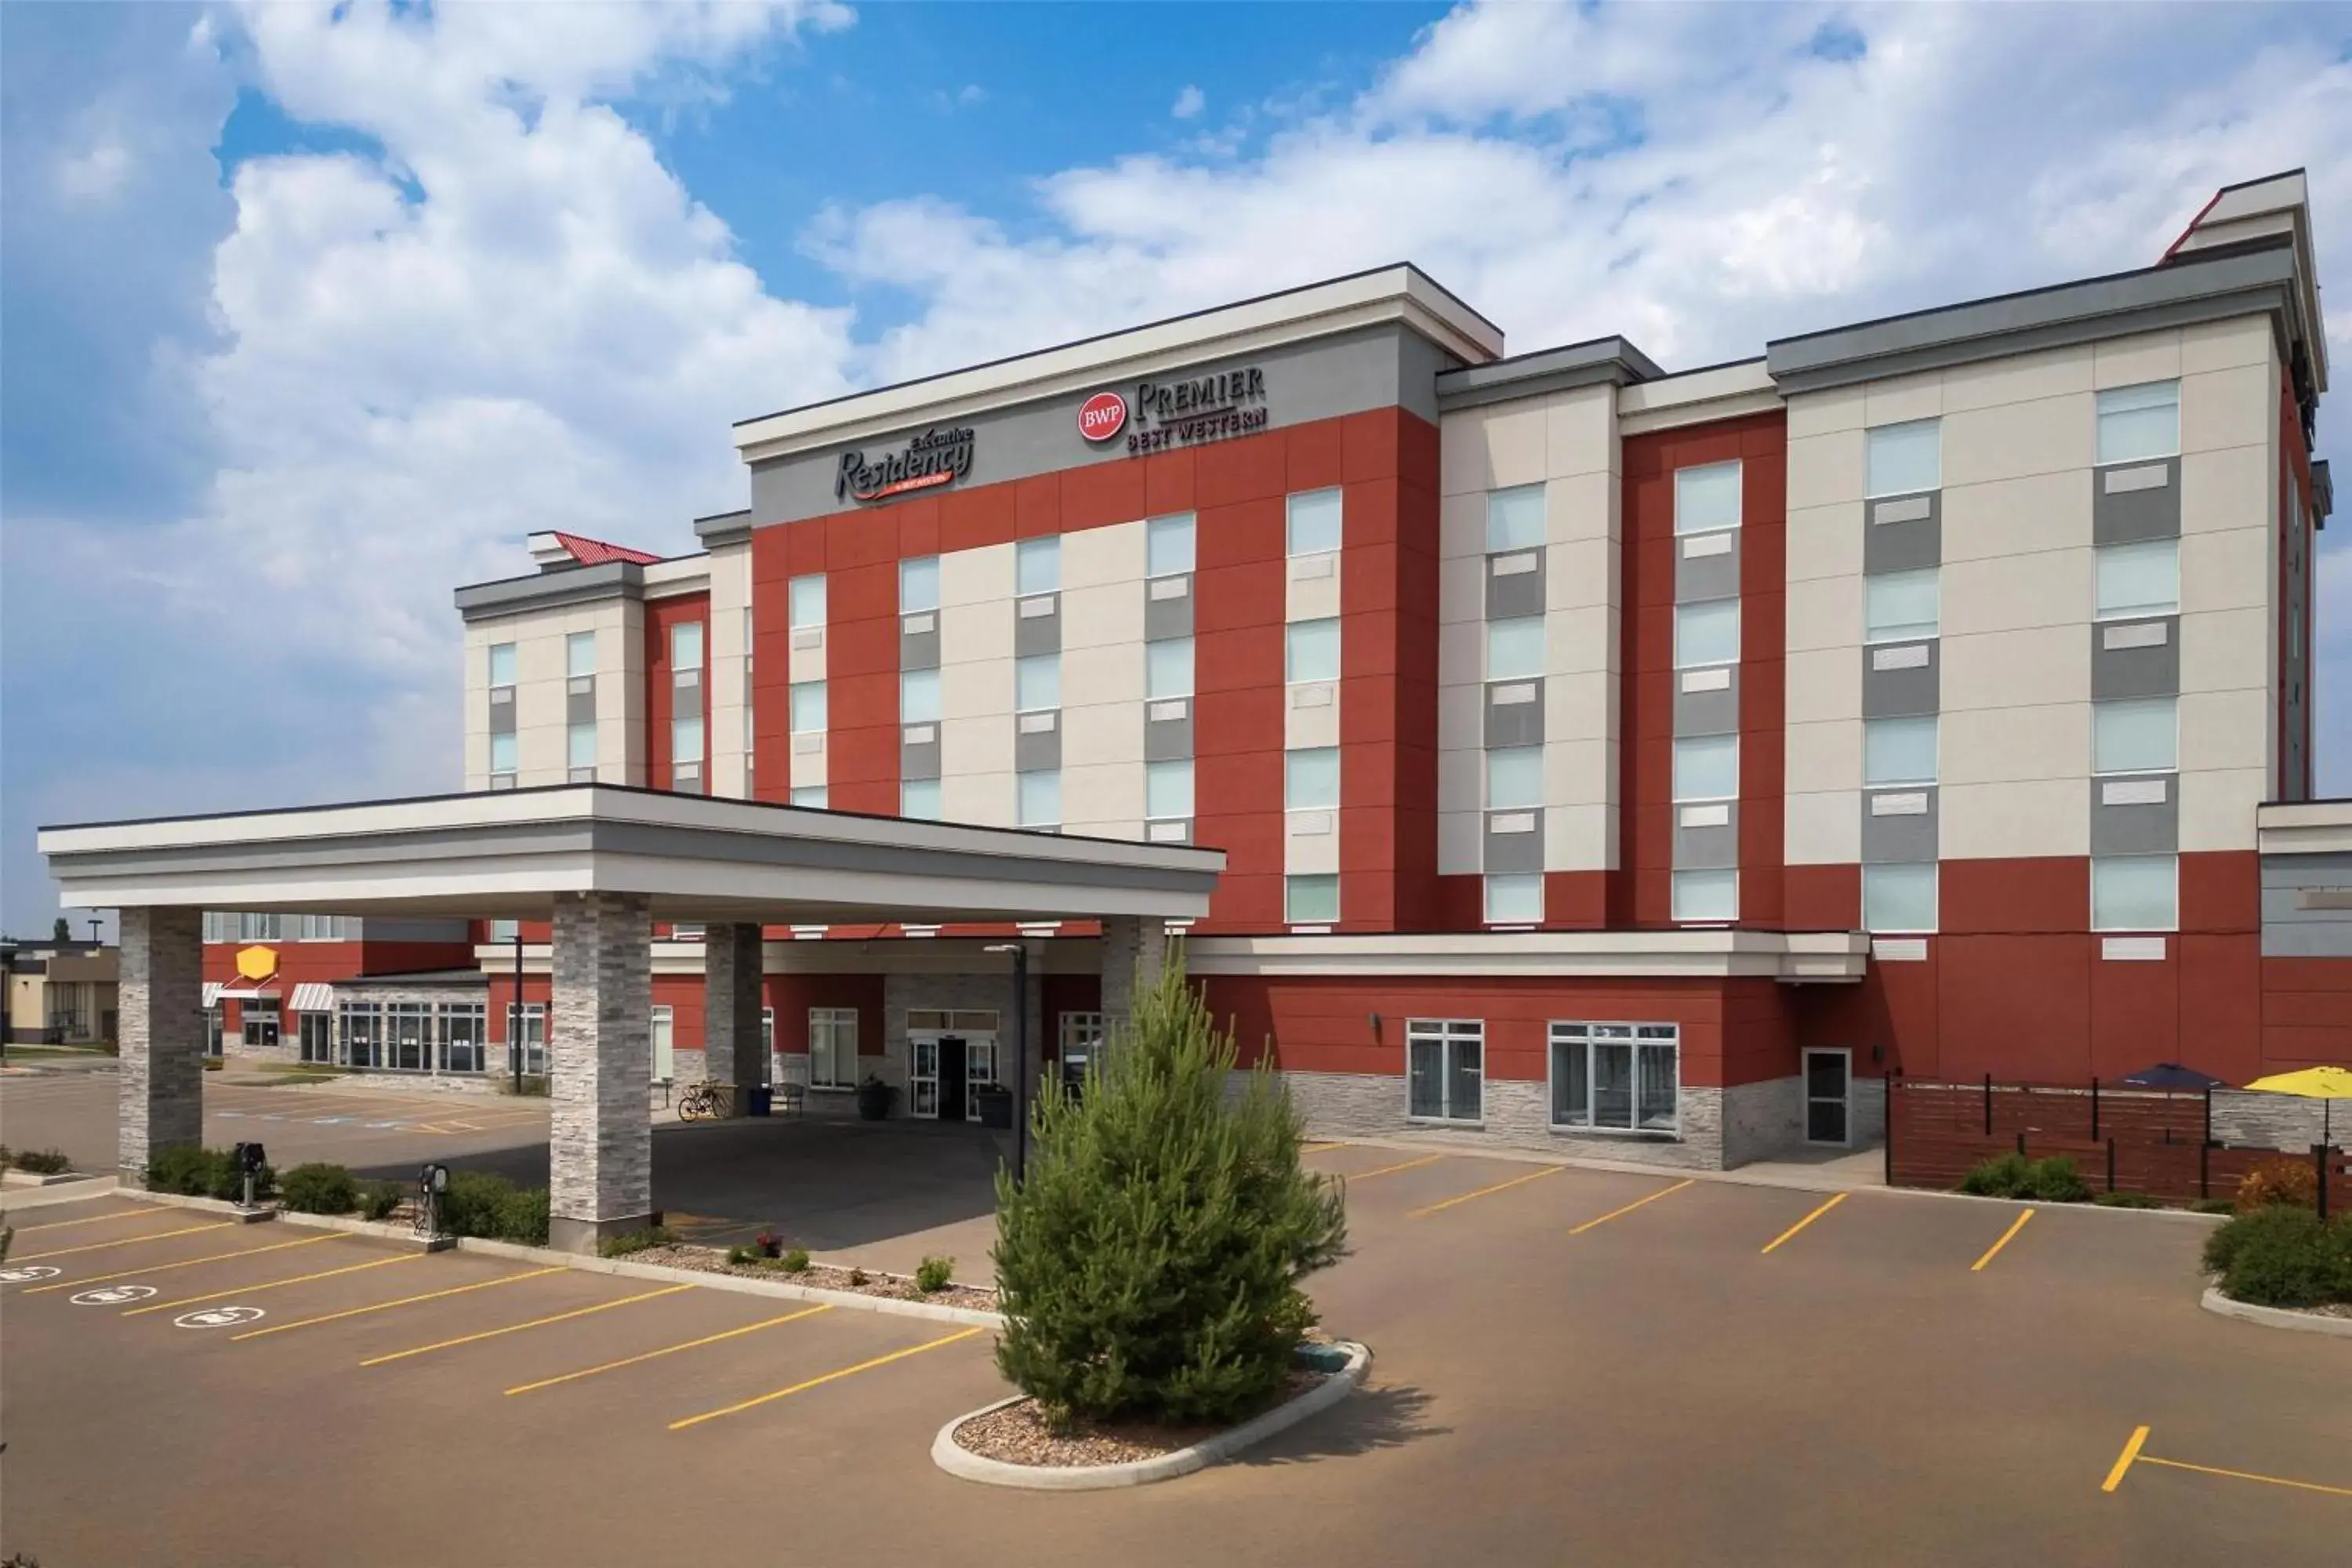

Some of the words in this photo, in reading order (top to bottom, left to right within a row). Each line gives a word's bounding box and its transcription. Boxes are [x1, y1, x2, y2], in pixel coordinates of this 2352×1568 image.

[1084, 405, 1120, 427] BWP
[1134, 366, 1266, 422] PREMIER
[1127, 428, 1172, 451] BEST
[1178, 406, 1268, 440] WESTERN
[837, 444, 975, 499] Residency
